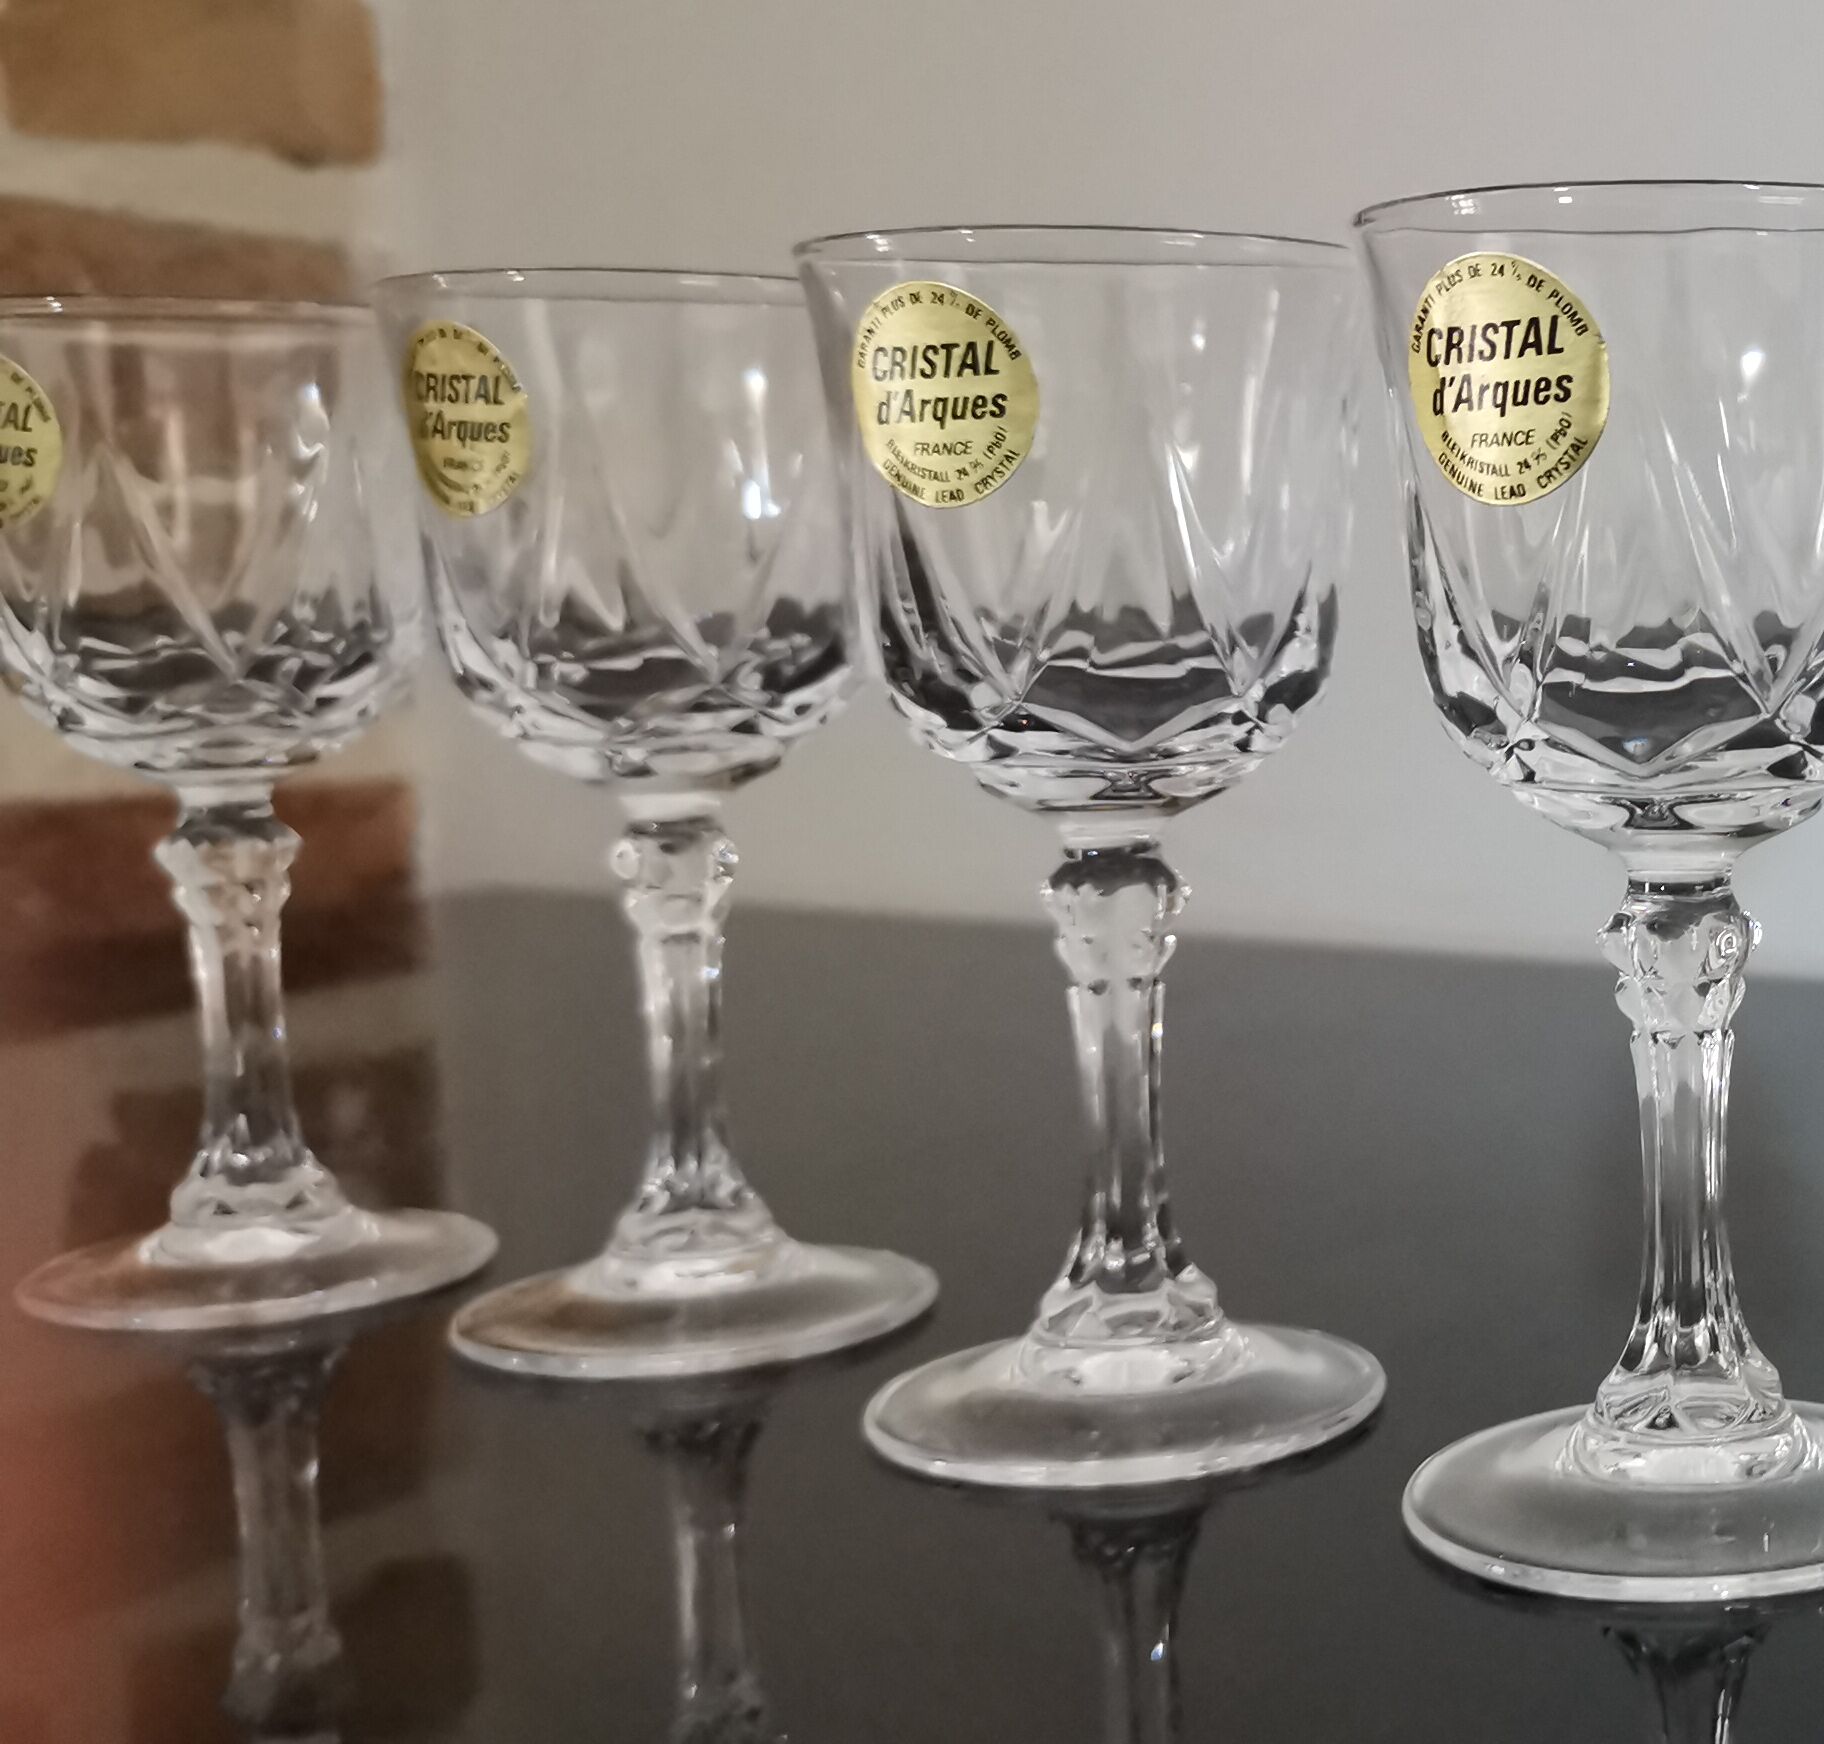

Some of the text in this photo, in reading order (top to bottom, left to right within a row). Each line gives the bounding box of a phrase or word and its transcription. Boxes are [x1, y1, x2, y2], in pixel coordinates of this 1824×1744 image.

[1411, 294, 1435, 354] GARANTI
[1435, 270, 1463, 297] PLUS
[1468, 263, 1482, 279] DE
[1491, 262, 1505, 277] 24
[1526, 274, 1545, 293] DE
[872, 340, 1000, 381] CRISTAL
[986, 317, 1022, 361] PLOMB
[1426, 314, 1565, 368] CRISTAL
[415, 373, 504, 405] CRISTAL
[877, 389, 1008, 429] d'Arques
[1432, 374, 1574, 418] d'Arques
[914, 441, 973, 456] FRANCE
[1441, 430, 1511, 478] BLEIKRISTALL
[1517, 458, 1532, 476] 24
[1471, 428, 1536, 449] FRANCE
[882, 449, 1020, 503] GENUINE LEAD CRYSTAL
[1438, 437, 1588, 500] GENUINE LEAD CRYSTAL
